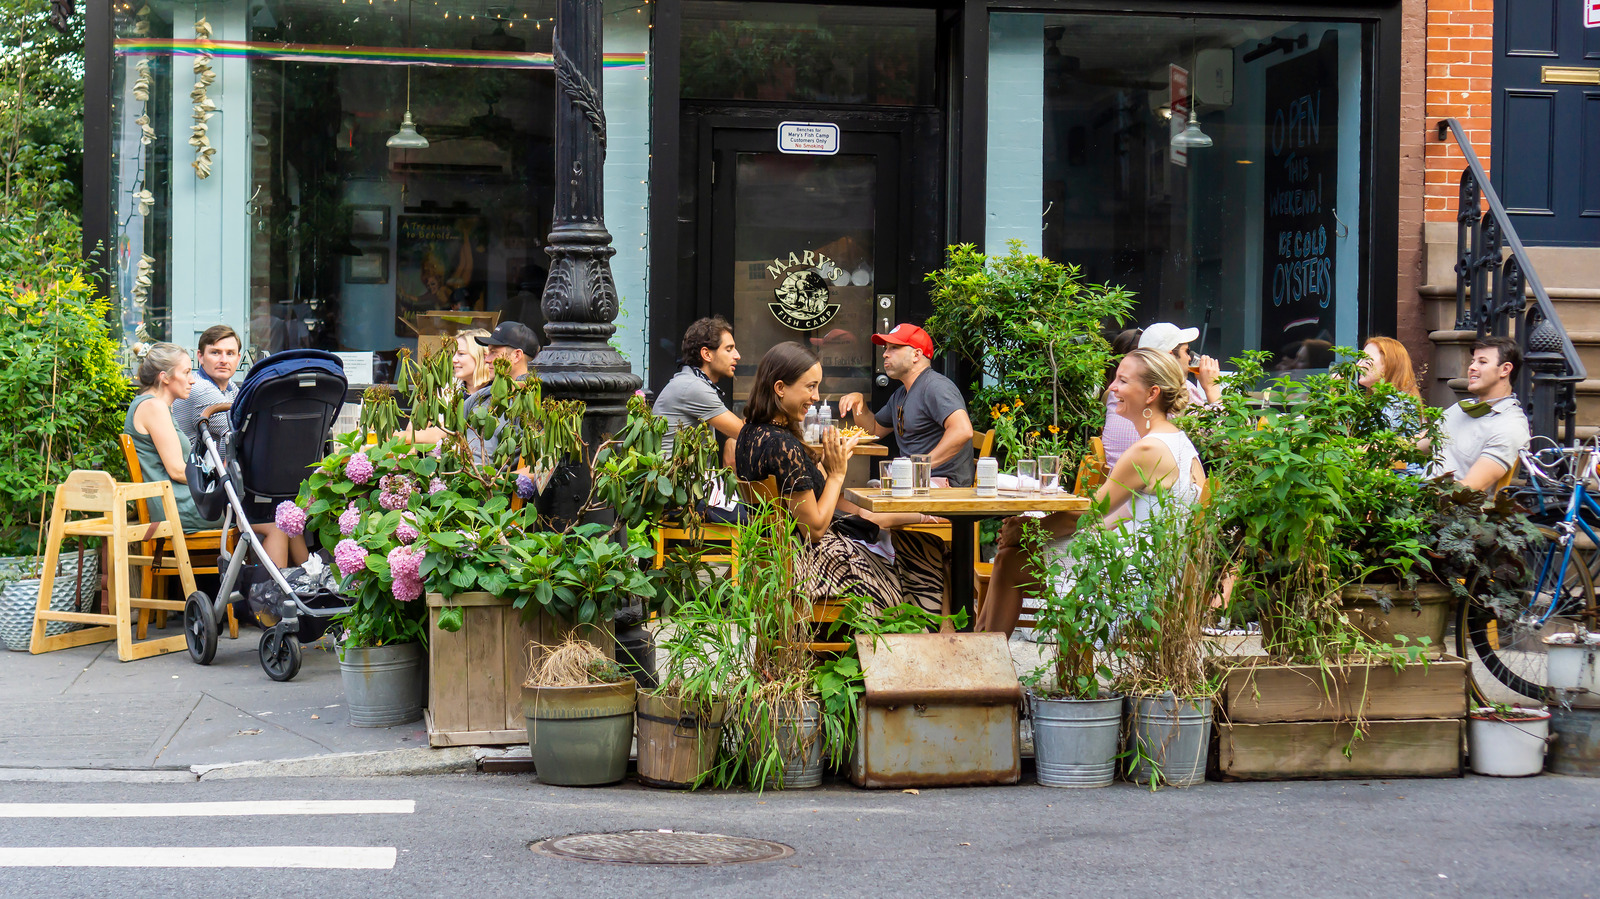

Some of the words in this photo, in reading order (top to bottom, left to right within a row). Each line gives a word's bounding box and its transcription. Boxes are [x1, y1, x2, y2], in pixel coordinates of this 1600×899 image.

[1272, 90, 1321, 157] OPEN
[1284, 152, 1310, 183] THIS
[1269, 172, 1322, 218] WEEKEND!
[402, 222, 409, 230] A
[411, 222, 451, 231] Treasure
[1278, 230, 1292, 259] ICE
[1294, 224, 1327, 258] COLD
[766, 249, 843, 281] MARY'S
[1272, 257, 1332, 309] OYSTERS
[777, 310, 800, 327] FISH
[805, 310, 831, 328] CAMP
